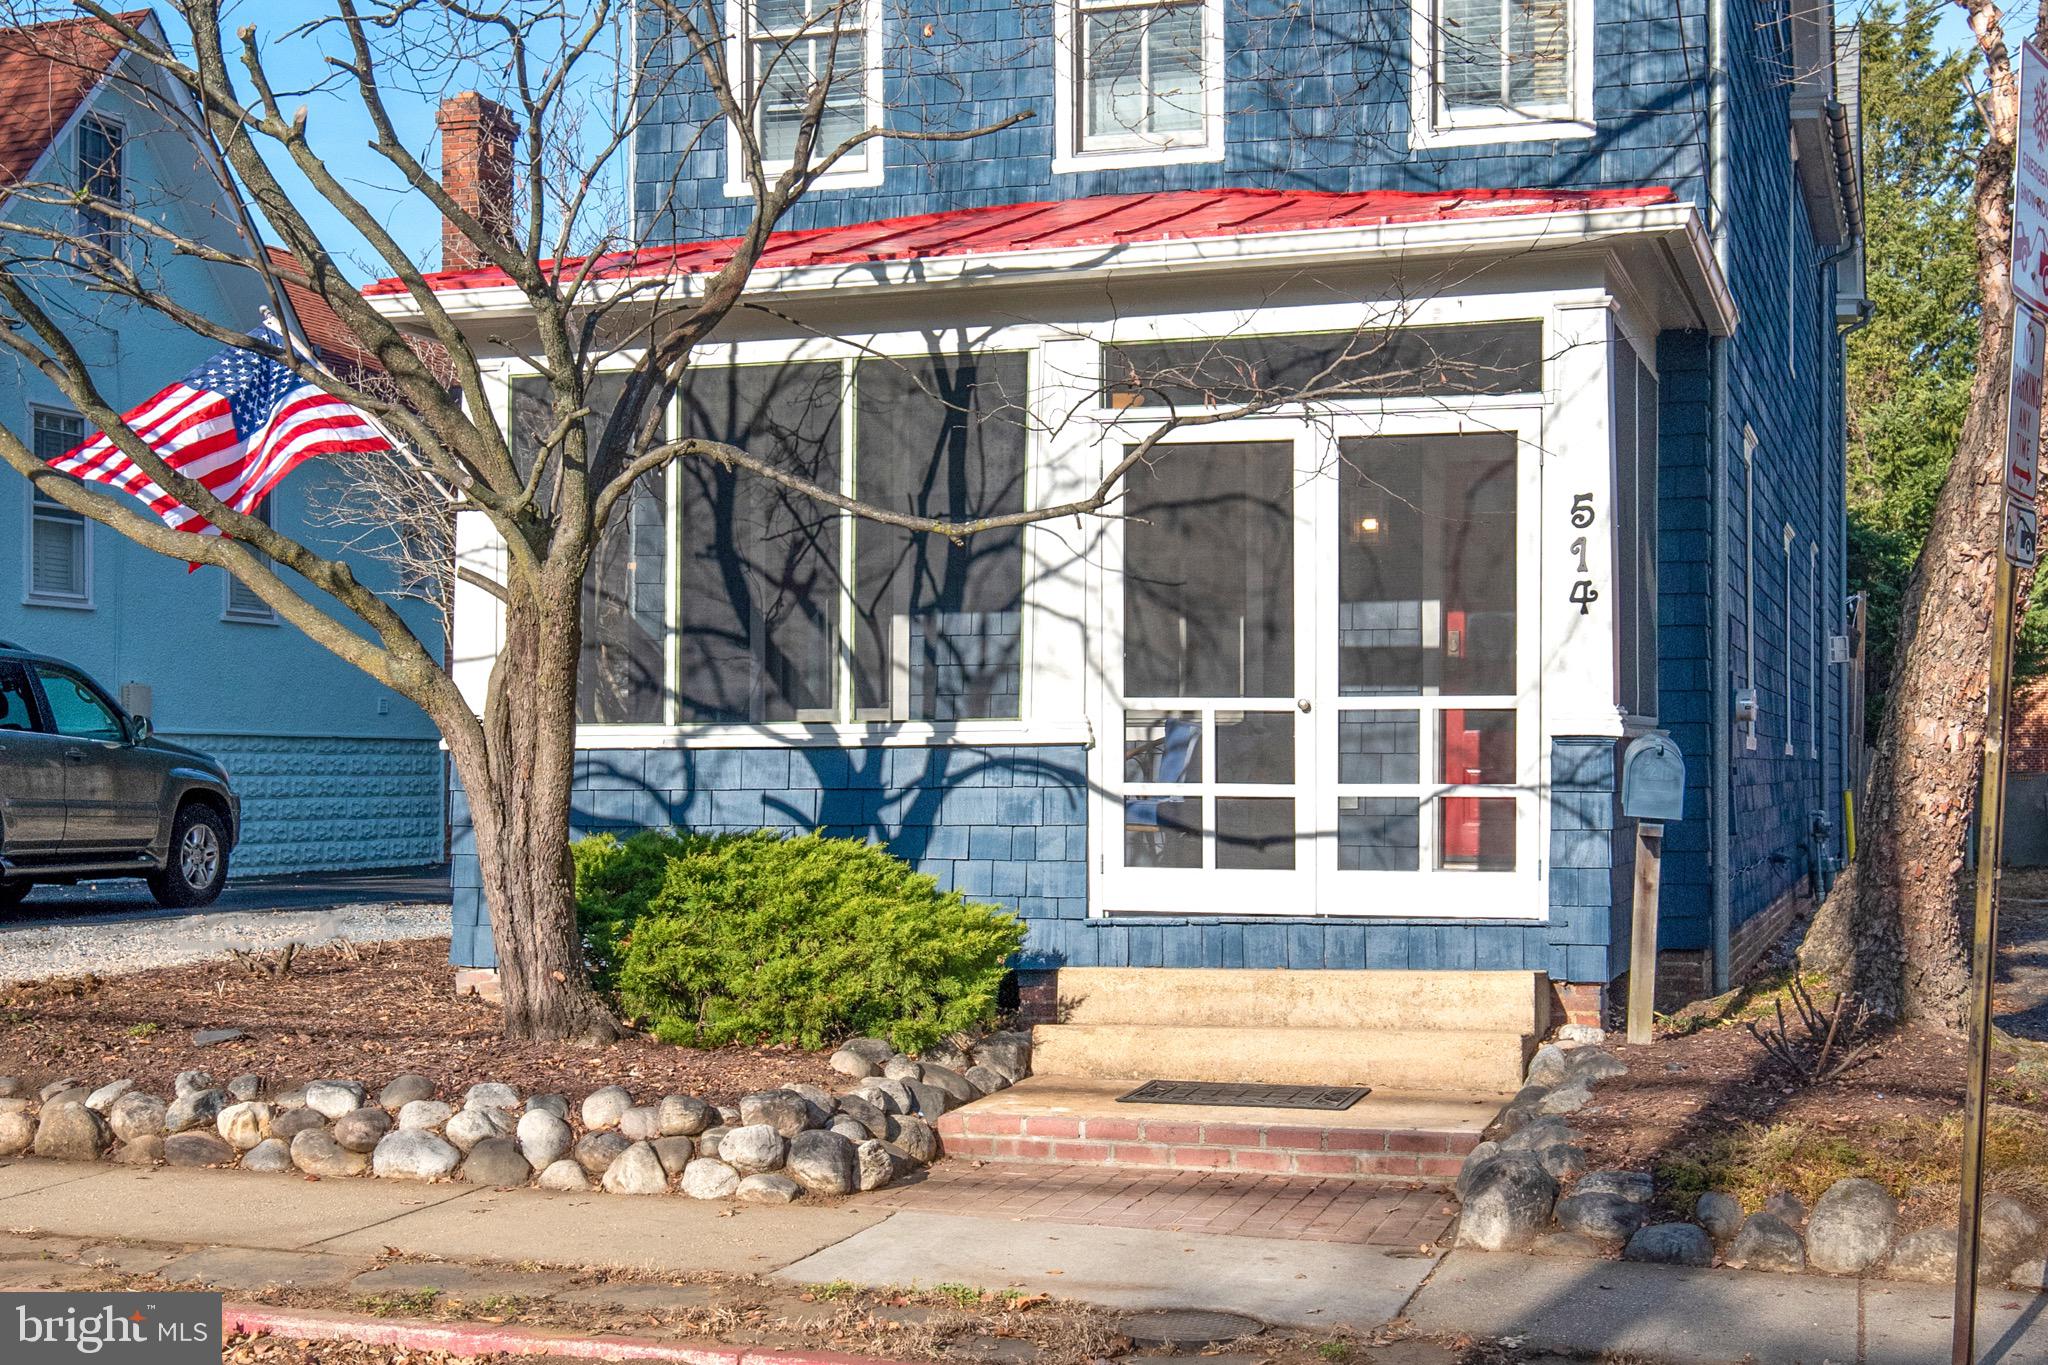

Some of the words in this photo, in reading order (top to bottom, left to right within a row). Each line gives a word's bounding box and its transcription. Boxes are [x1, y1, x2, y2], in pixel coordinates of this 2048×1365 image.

[2022, 325, 2035, 365] NO
[2012, 363, 2040, 411] PARKING
[2018, 407, 2032, 432] ANY
[2016, 432, 2031, 461] TIME
[1569, 492, 1599, 615] 514
